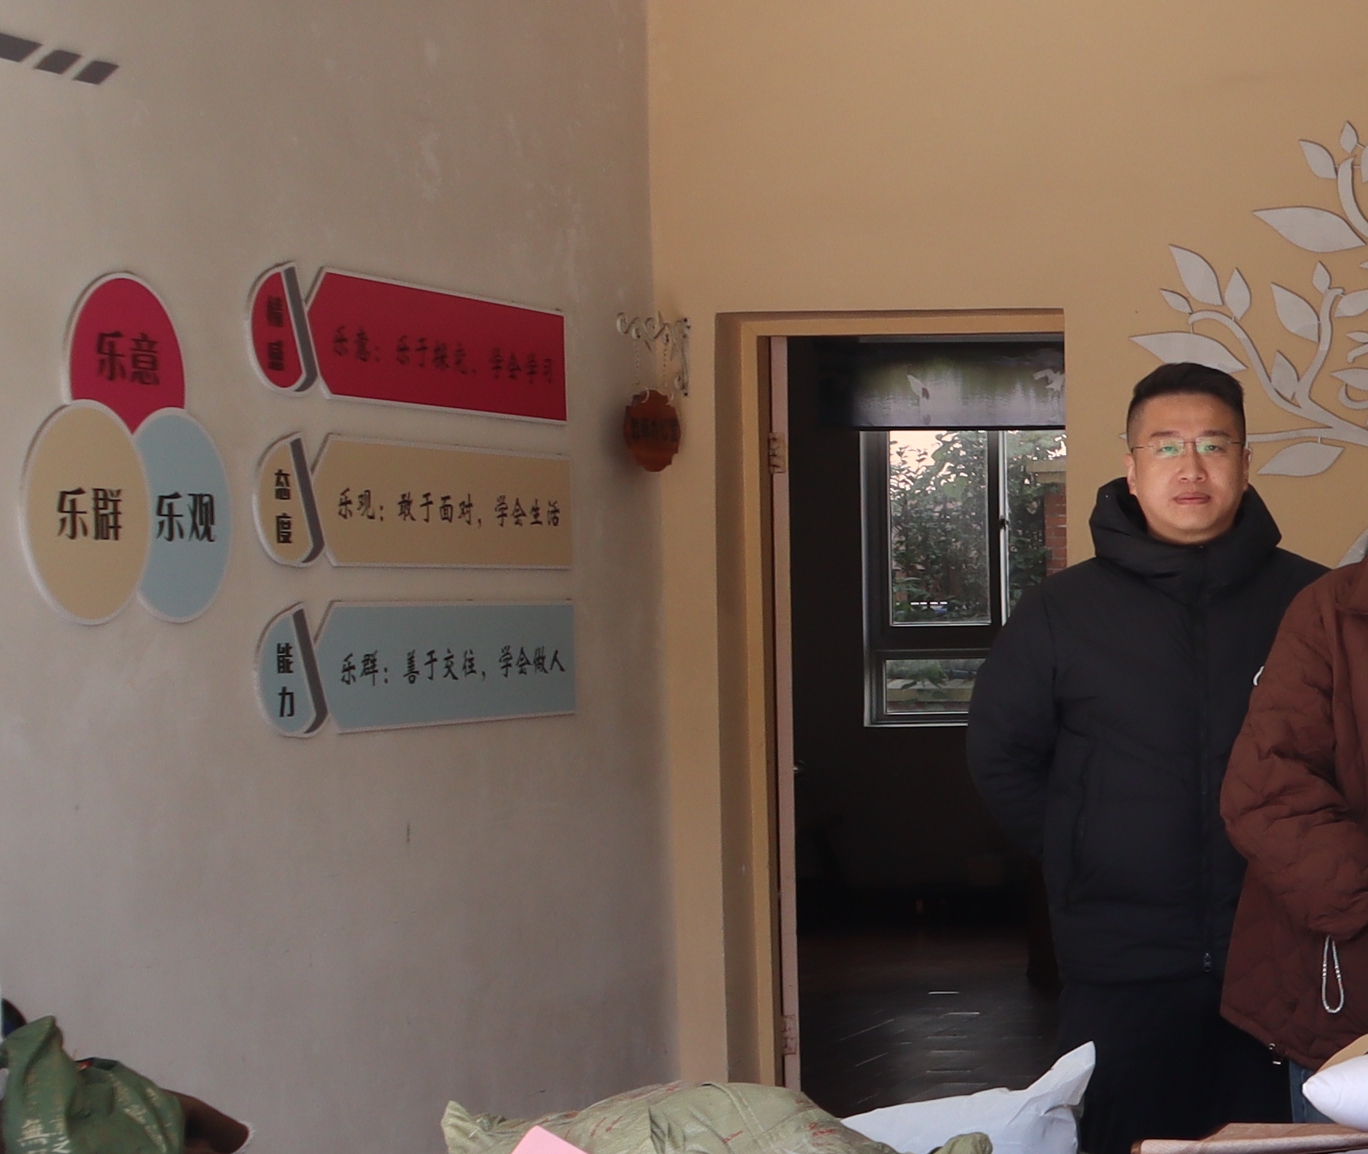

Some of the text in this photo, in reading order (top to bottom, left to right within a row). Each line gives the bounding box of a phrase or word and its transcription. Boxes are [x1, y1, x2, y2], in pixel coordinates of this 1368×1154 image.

[94, 331, 160, 385] 乐意
[56, 487, 123, 542] 乐群
[155, 491, 216, 543] 乐观
[274, 469, 292, 544] 态度
[276, 643, 294, 717] 能力
